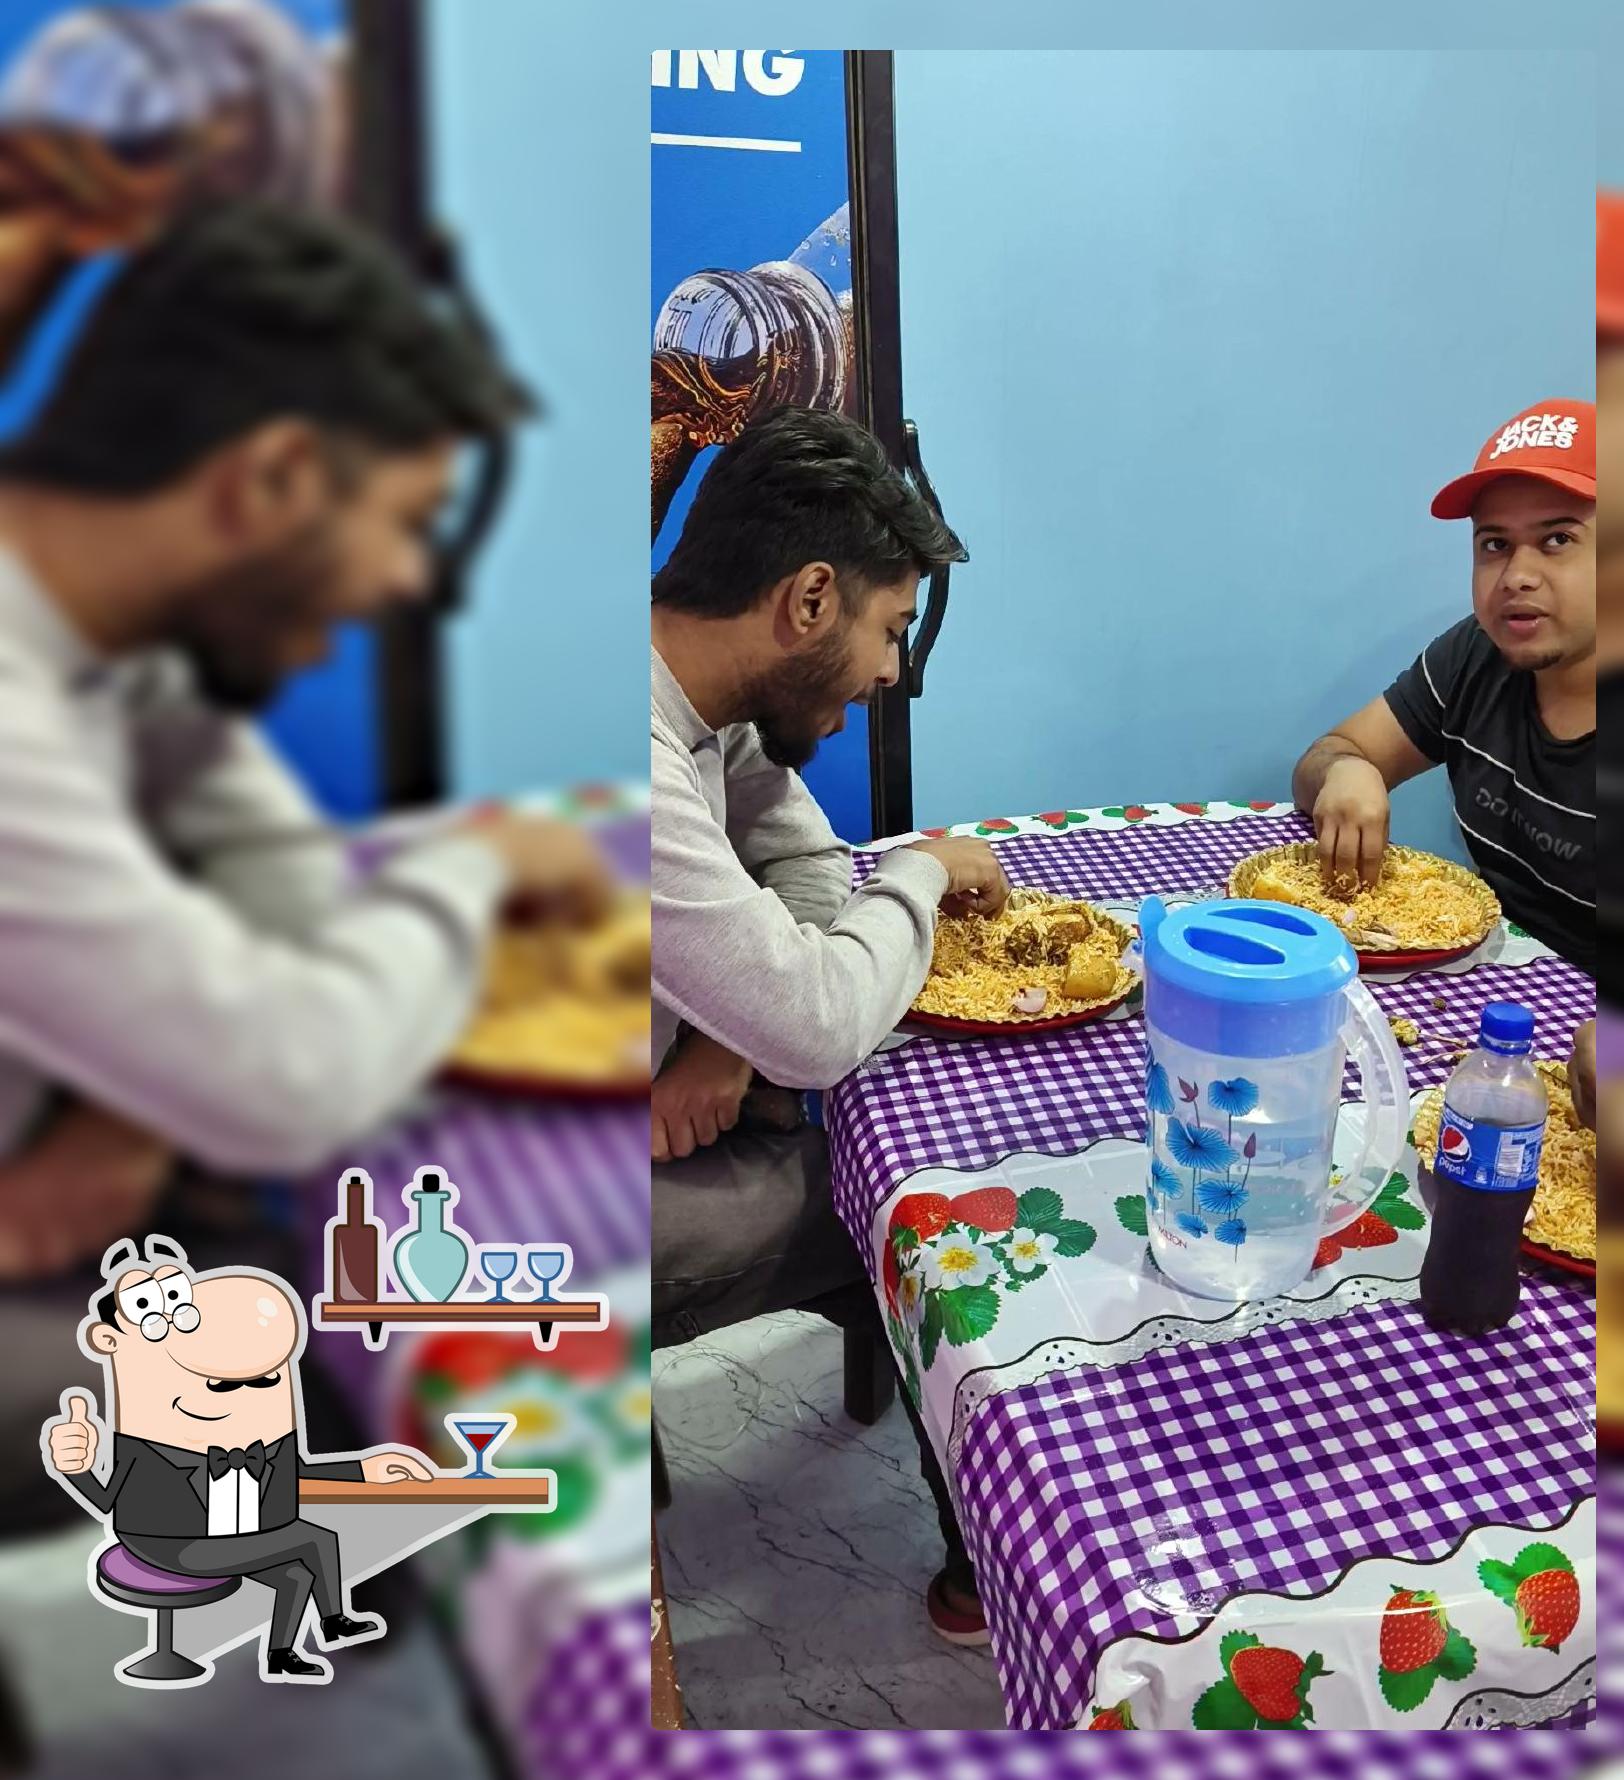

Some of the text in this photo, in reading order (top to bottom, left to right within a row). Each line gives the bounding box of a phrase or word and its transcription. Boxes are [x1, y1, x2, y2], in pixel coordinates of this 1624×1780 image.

[1489, 430, 1573, 460] JONES
[1475, 787, 1509, 817] DO
[1438, 1156, 1467, 1176] pepsi
